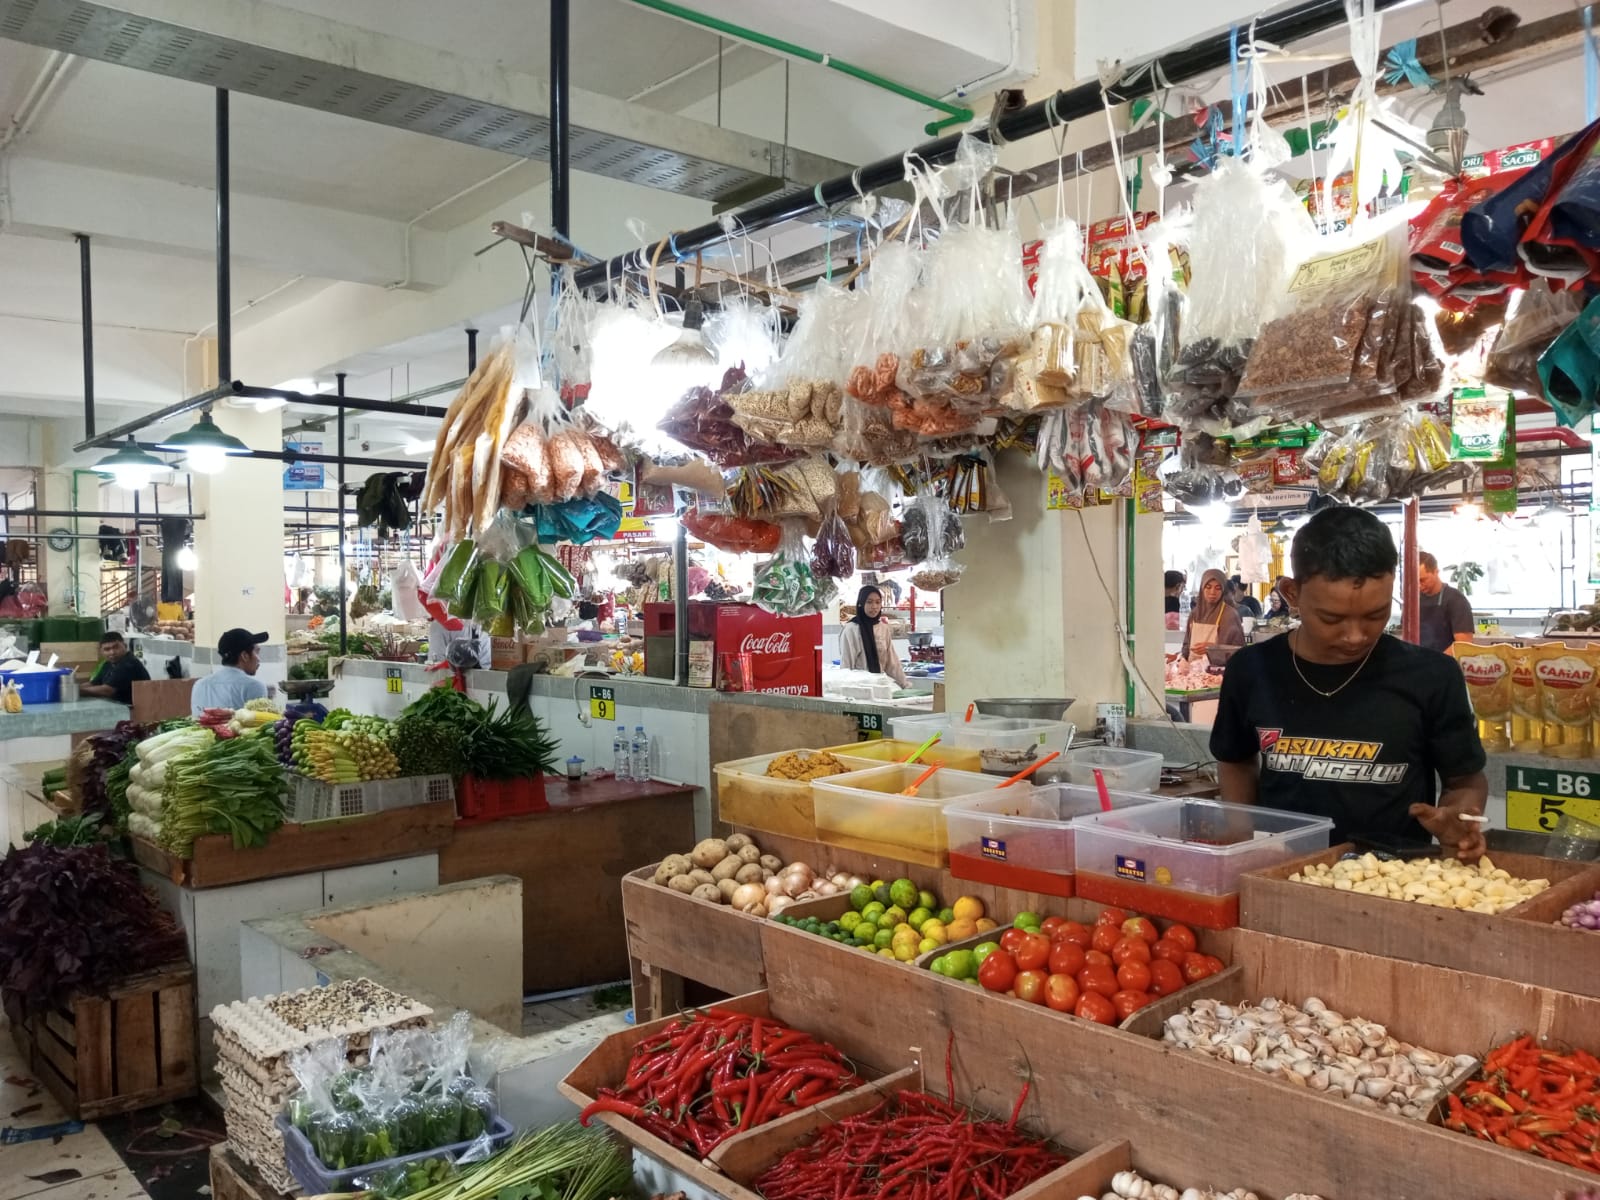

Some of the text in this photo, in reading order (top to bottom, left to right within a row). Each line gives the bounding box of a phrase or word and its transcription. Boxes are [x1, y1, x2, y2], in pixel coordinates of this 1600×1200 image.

[1461, 156, 1481, 168] ORI
[1502, 152, 1538, 167] SAORI
[623, 530, 647, 538] PASAR
[740, 632, 792, 655] Coca-Cola
[390, 679, 398, 692] 11
[598, 700, 606, 718] 9
[1256, 727, 1383, 762] PASUKAN
[1266, 752, 1408, 784] ANTI NGELUH
[1538, 797, 1567, 832] 5
